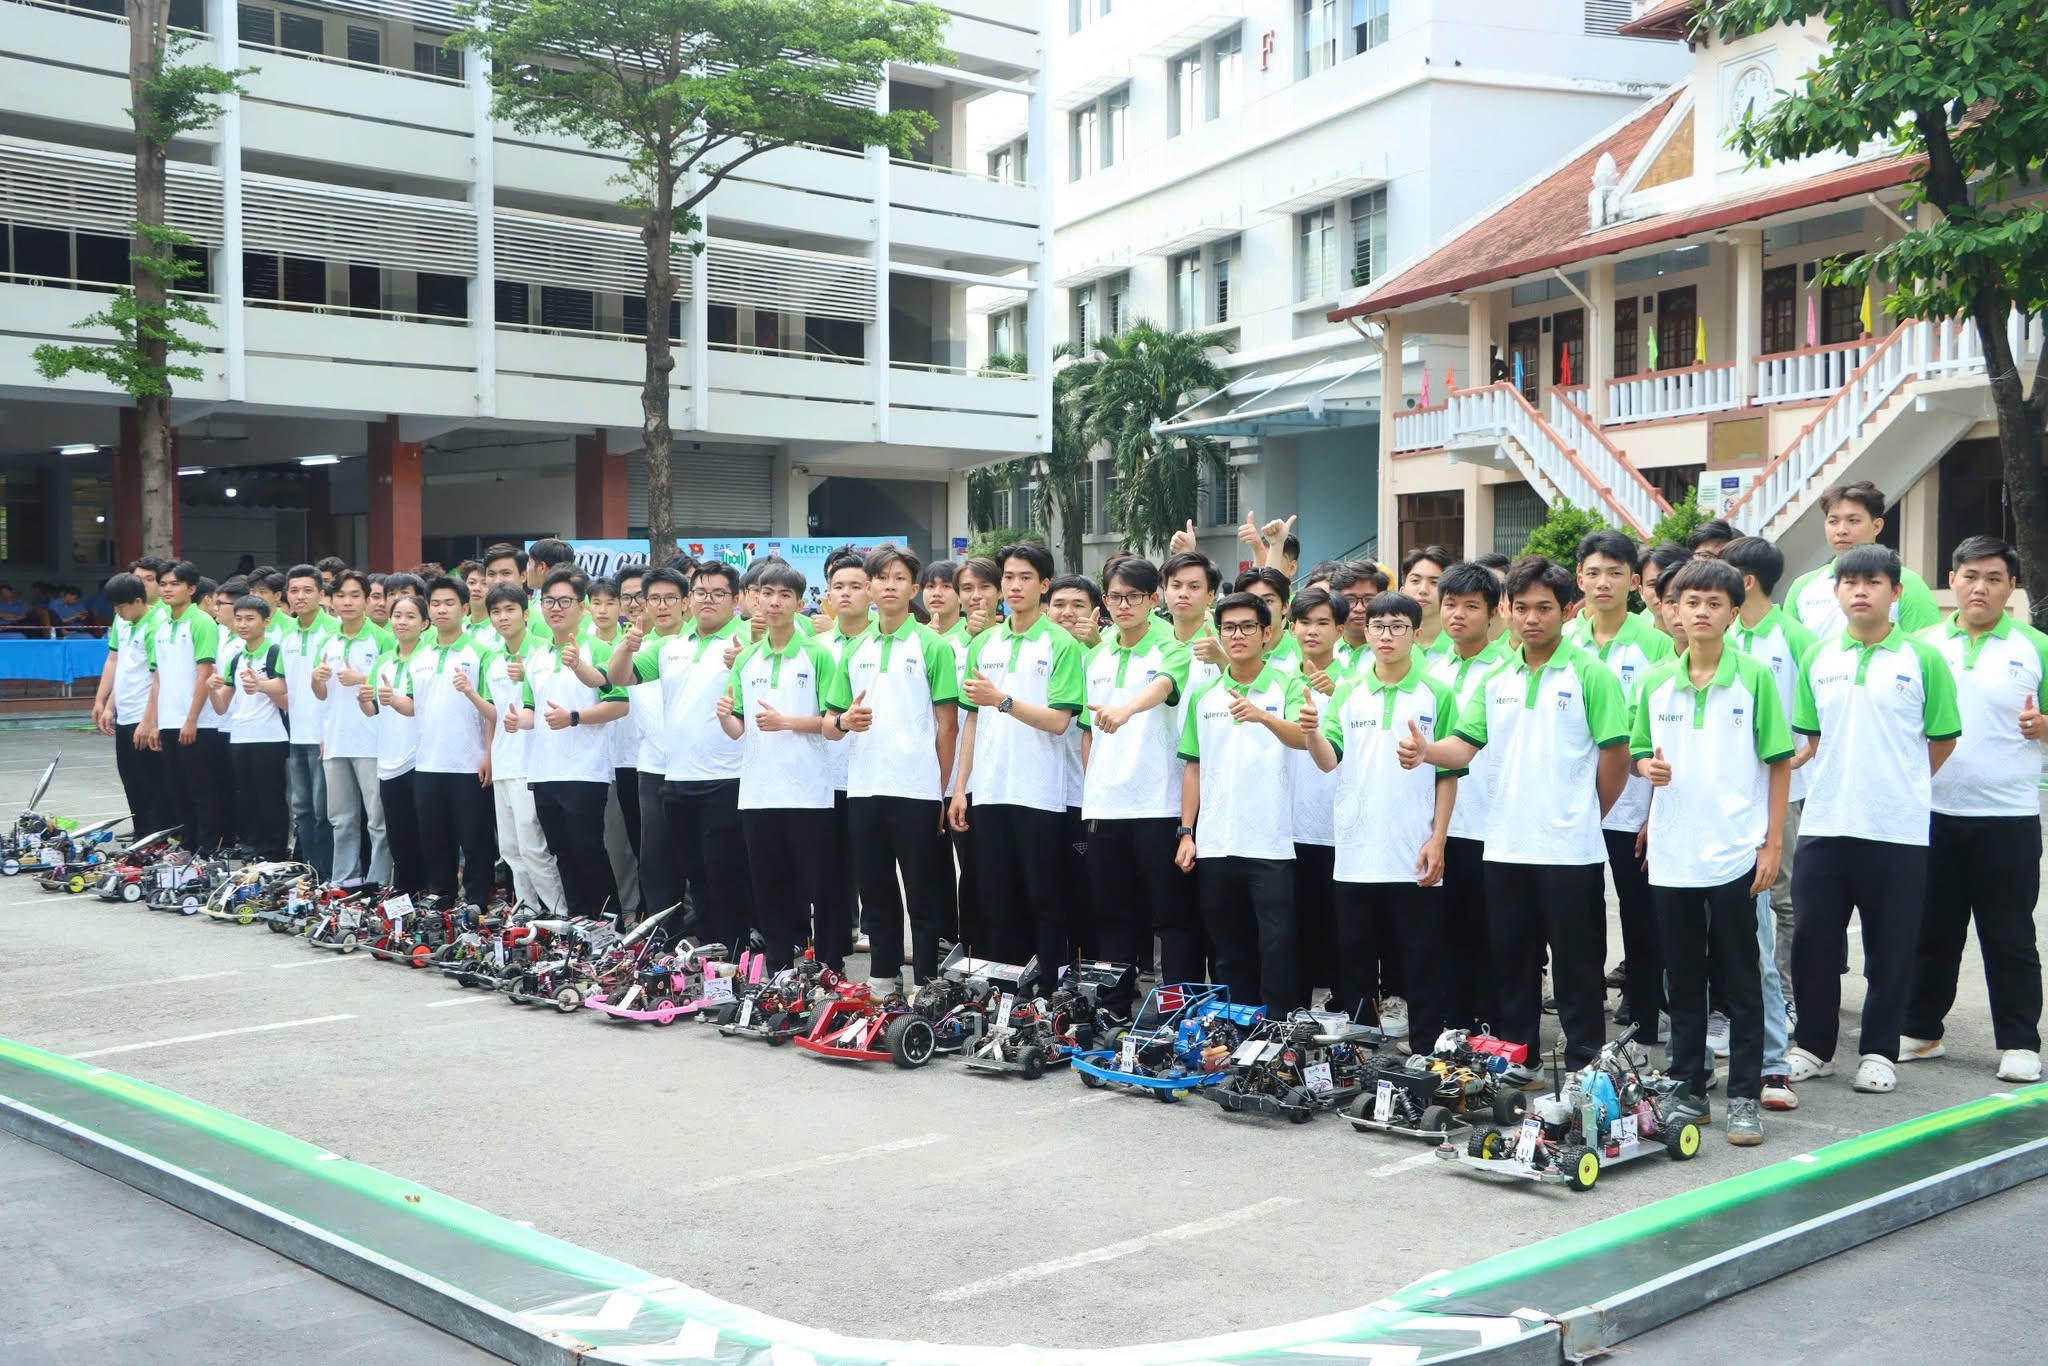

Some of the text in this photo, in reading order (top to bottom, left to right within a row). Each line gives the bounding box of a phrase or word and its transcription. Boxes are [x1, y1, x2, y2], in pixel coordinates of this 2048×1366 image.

[1260, 30, 1275, 71] F
[791, 543, 834, 554] Niterra
[1658, 713, 1684, 722] Niterr
